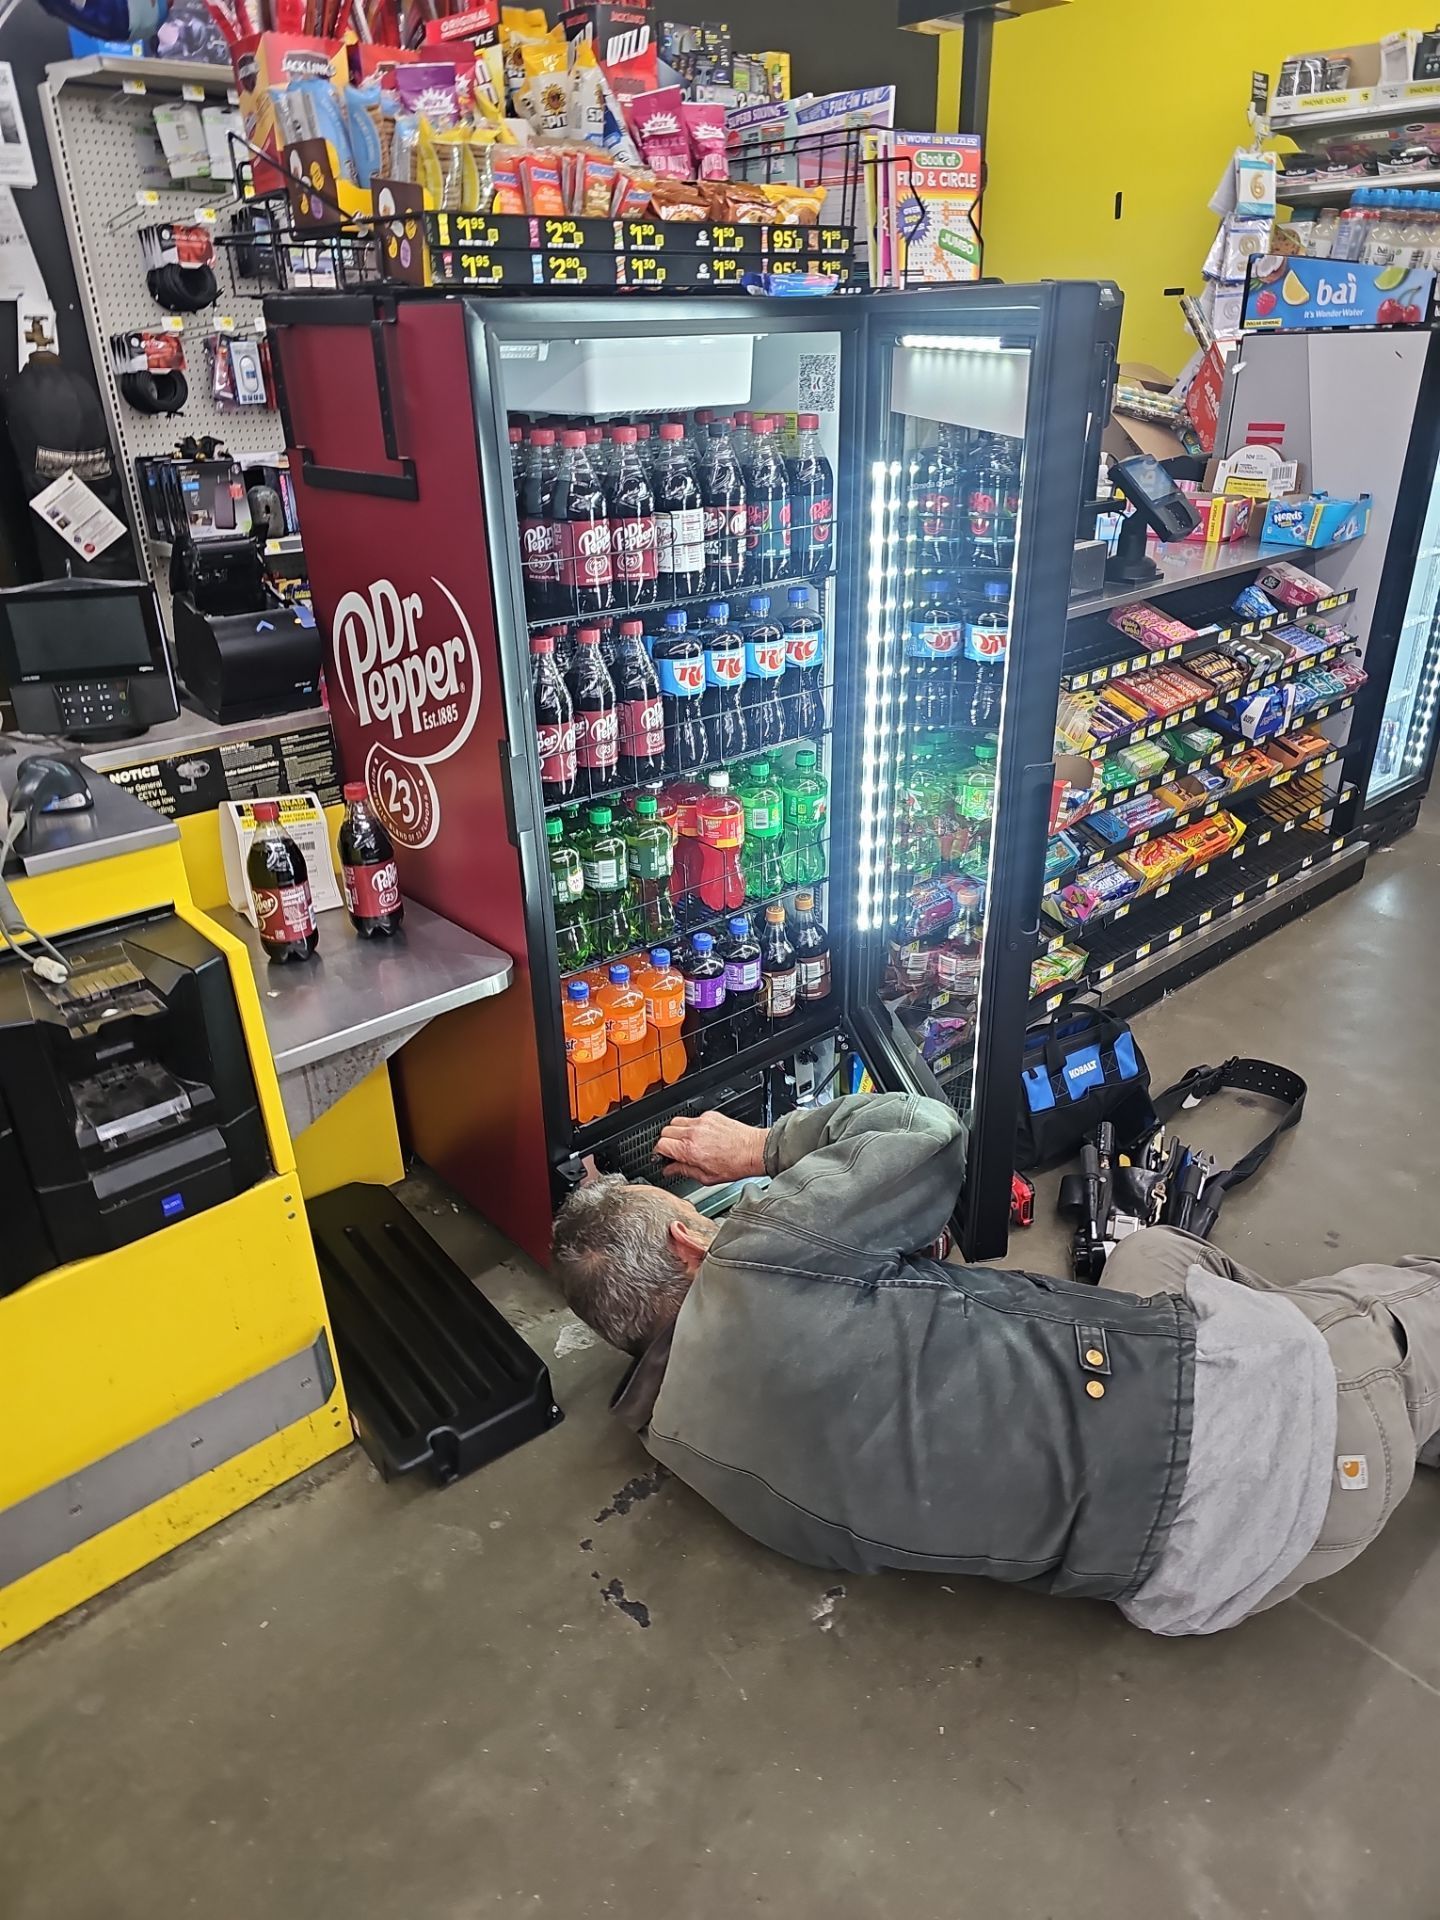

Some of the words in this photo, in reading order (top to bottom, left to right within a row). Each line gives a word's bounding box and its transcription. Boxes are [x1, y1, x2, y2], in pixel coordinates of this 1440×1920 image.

[441, 8, 490, 32] ORIGINAL
[920, 153, 944, 166] Book
[946, 154, 956, 166] of
[927, 171, 937, 187] &
[939, 172, 977, 188] CIRCLE
[1250, 171, 1266, 200] 6
[941, 233, 974, 255] JUMBO
[1317, 272, 1357, 306] bai
[1304, 311, 1315, 319] It's
[368, 579, 423, 664] Dr
[786, 641, 816, 661] RC
[333, 591, 465, 740] Pepper
[109, 765, 160, 784] NOTICE
[135, 779, 163, 793] General
[138, 790, 158, 802] CCTV
[384, 769, 415, 824] 23
[1068, 1060, 1098, 1079] KOBALT
